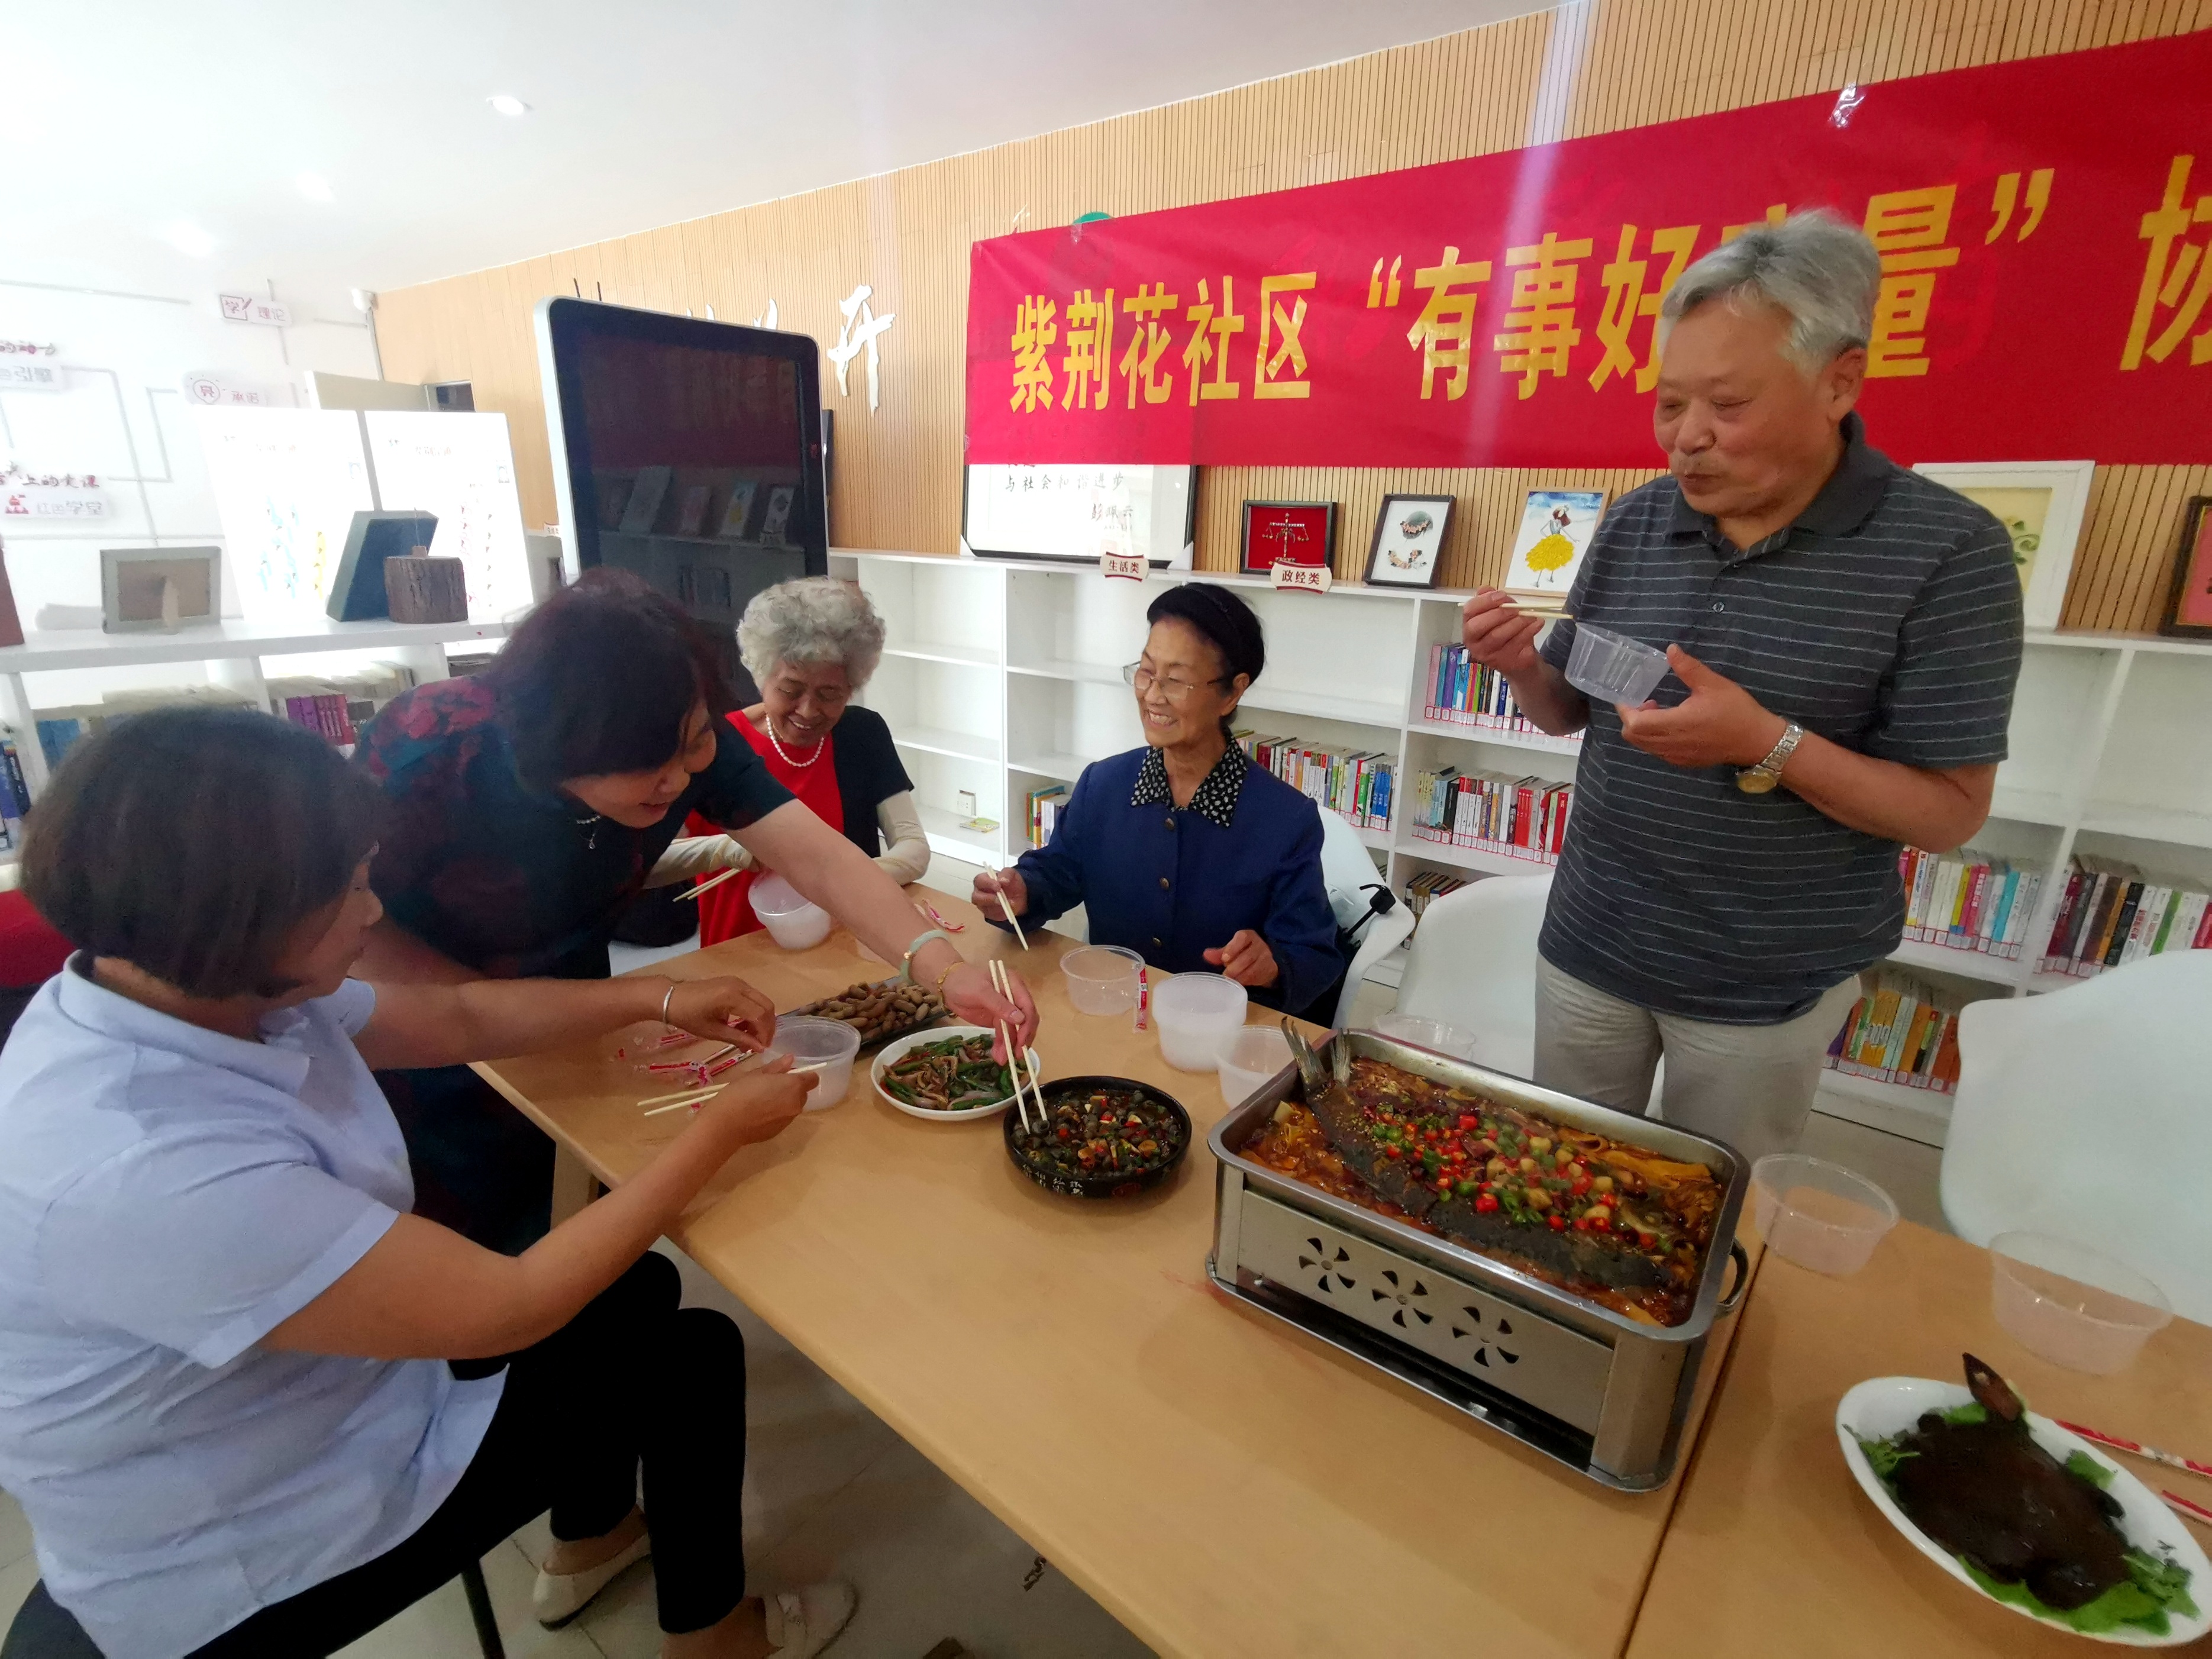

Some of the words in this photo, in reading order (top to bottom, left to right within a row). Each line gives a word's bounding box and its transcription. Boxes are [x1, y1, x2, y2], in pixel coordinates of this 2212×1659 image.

[1009, 272, 1317, 414] 紫荆花社区
[1367, 168, 2055, 401] “有事好量”
[1005, 470, 1125, 493] 与社会和谐进步
[1108, 559, 1140, 574] 生活类
[1281, 569, 1320, 586] 政经类
